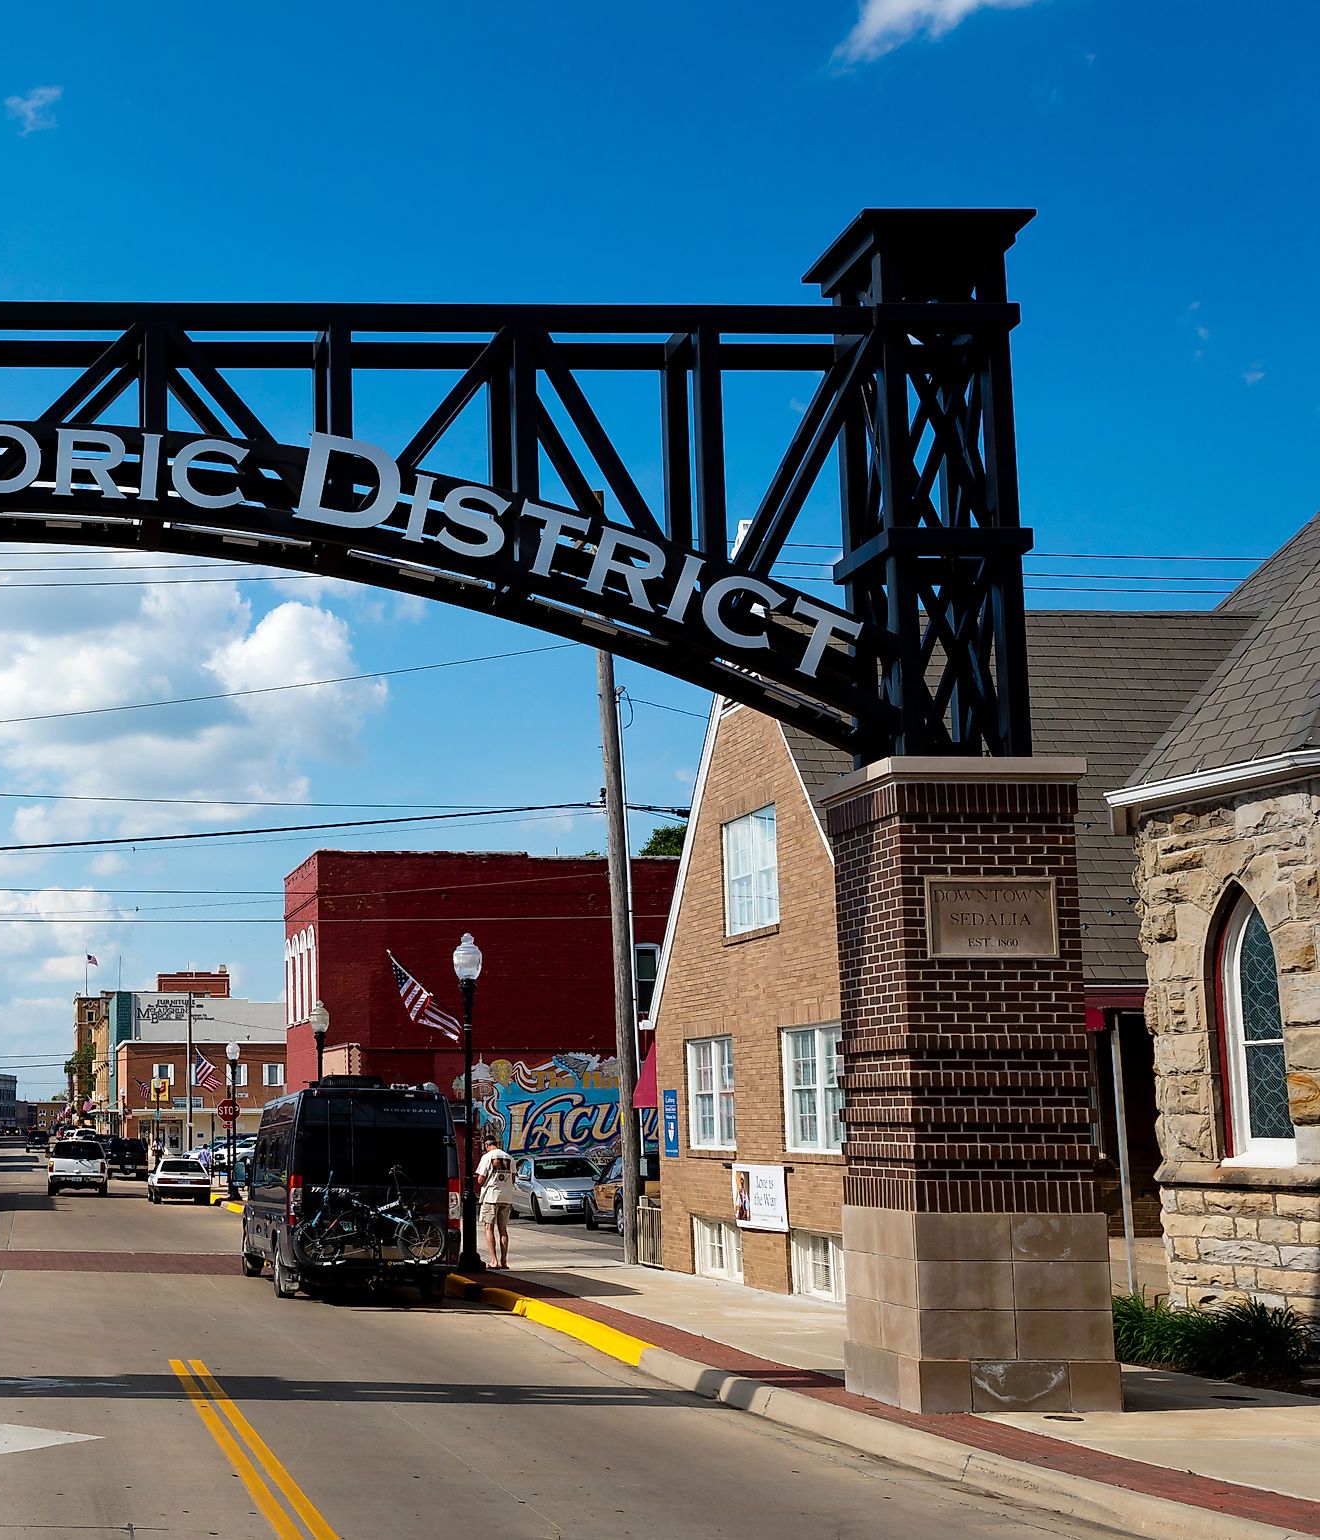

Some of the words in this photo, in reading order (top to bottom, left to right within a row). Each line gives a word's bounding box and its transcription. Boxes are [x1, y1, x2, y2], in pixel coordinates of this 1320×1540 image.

[294, 432, 863, 678] DISTRICT
[933, 889, 1047, 903] DOWNTOWN
[950, 912, 1031, 926] SEDALIA
[968, 937, 994, 947] EST.
[998, 938, 1019, 947] 1860
[532, 1070, 576, 1089] The
